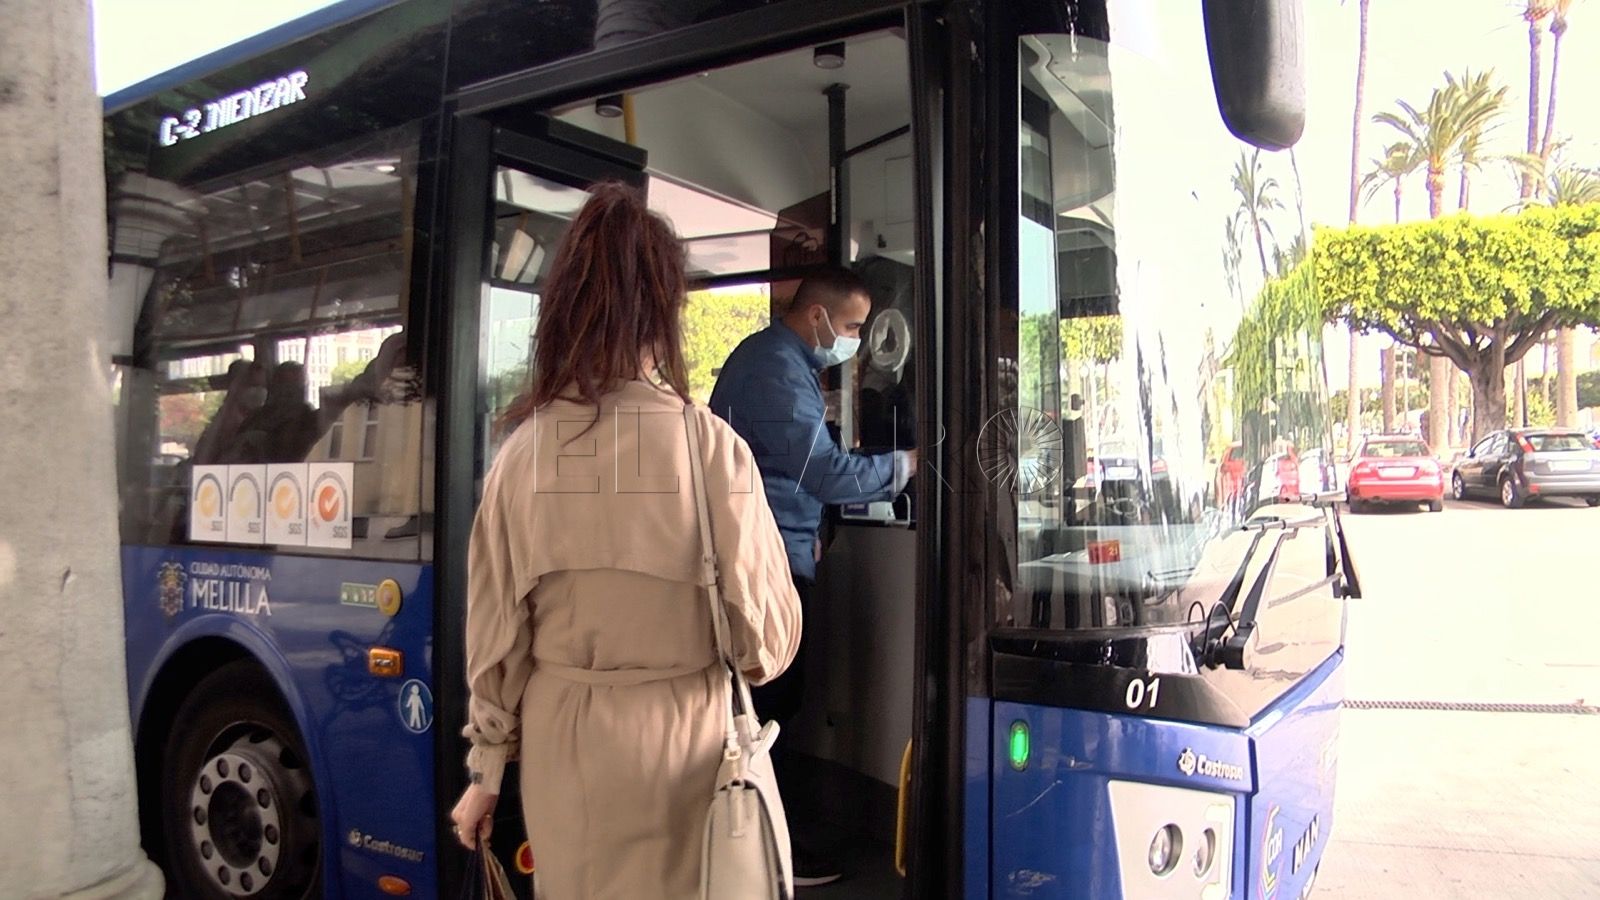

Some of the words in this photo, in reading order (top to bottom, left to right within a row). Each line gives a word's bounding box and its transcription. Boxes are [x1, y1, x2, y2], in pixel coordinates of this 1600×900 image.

[191, 561, 220, 576] CIUDAD
[191, 578, 272, 617] MELILLA
[1126, 677, 1160, 709] 01
